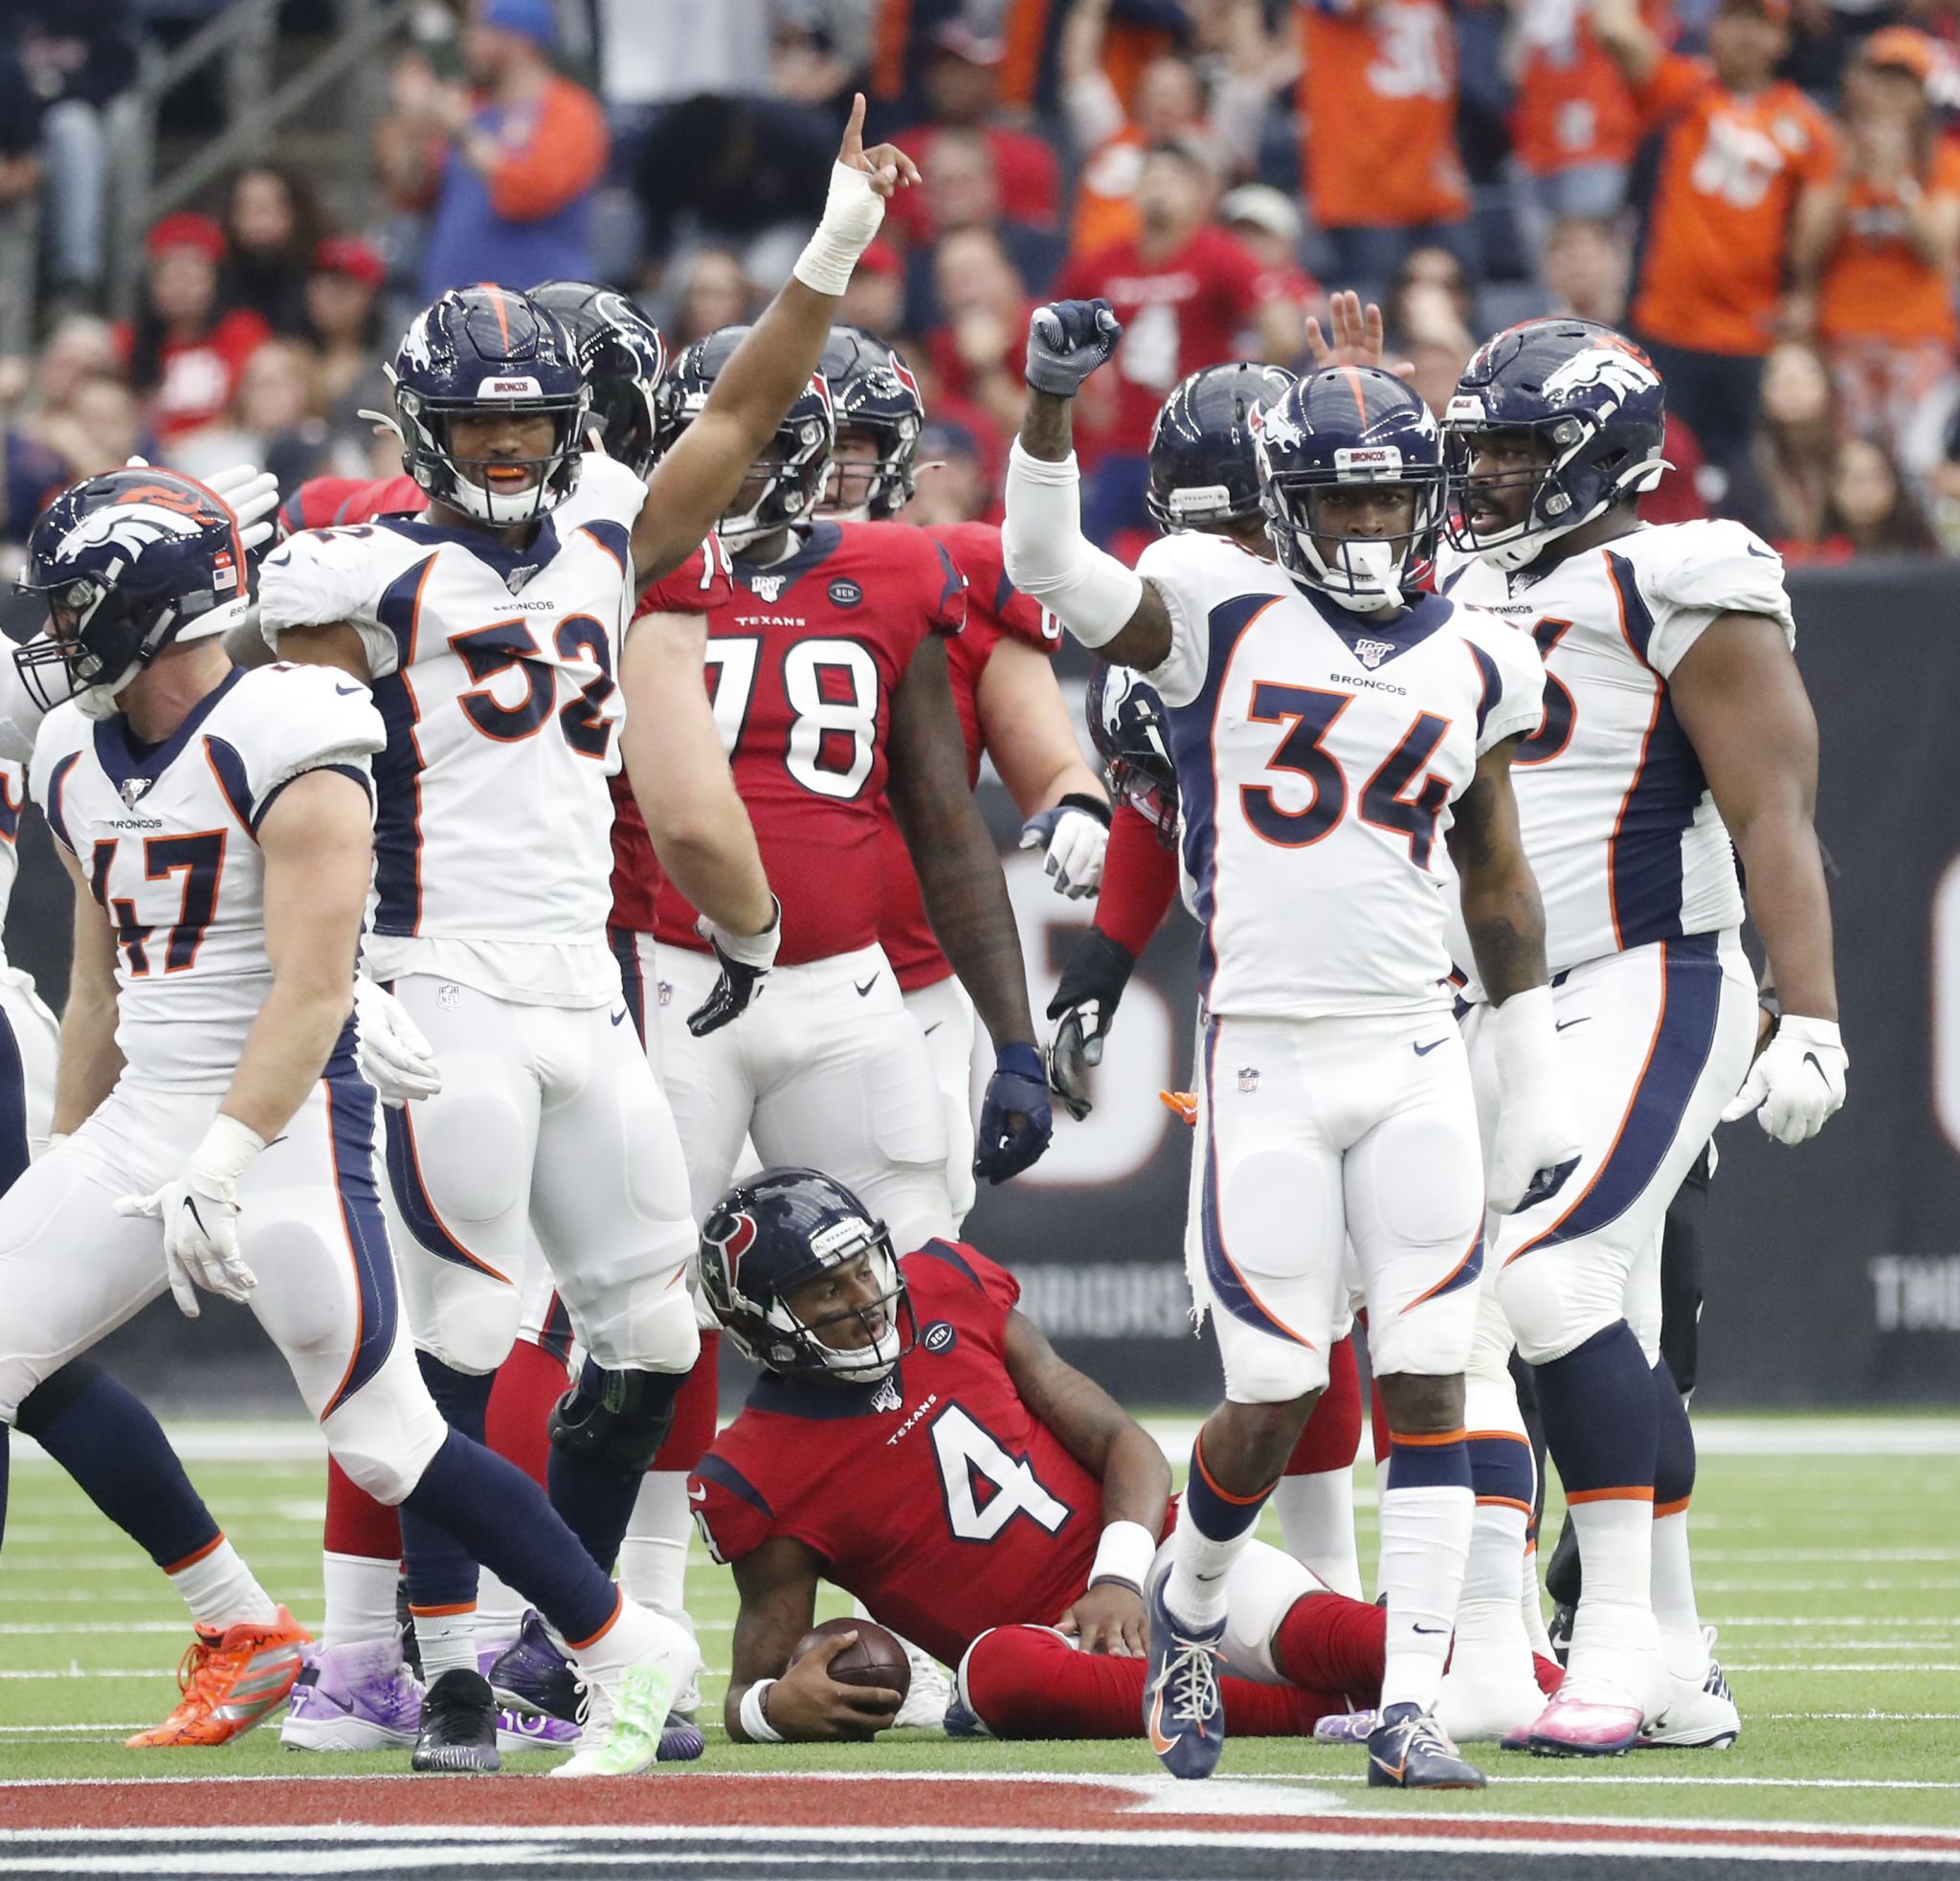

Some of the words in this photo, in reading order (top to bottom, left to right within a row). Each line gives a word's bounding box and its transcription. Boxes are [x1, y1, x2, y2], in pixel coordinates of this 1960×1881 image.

[494, 382, 528, 392] BRONCOS
[1350, 451, 1386, 462] BRONCOS
[493, 601, 554, 612] BRONCOS
[734, 616, 806, 627] TEXANS
[446, 613, 616, 761] 52
[1330, 673, 1407, 696] BRONCOS
[703, 634, 881, 803] 78
[1239, 680, 1454, 873] 34
[91, 827, 229, 977] 47
[886, 1394, 937, 1445] TEXANS
[926, 1397, 1076, 1545] 4
